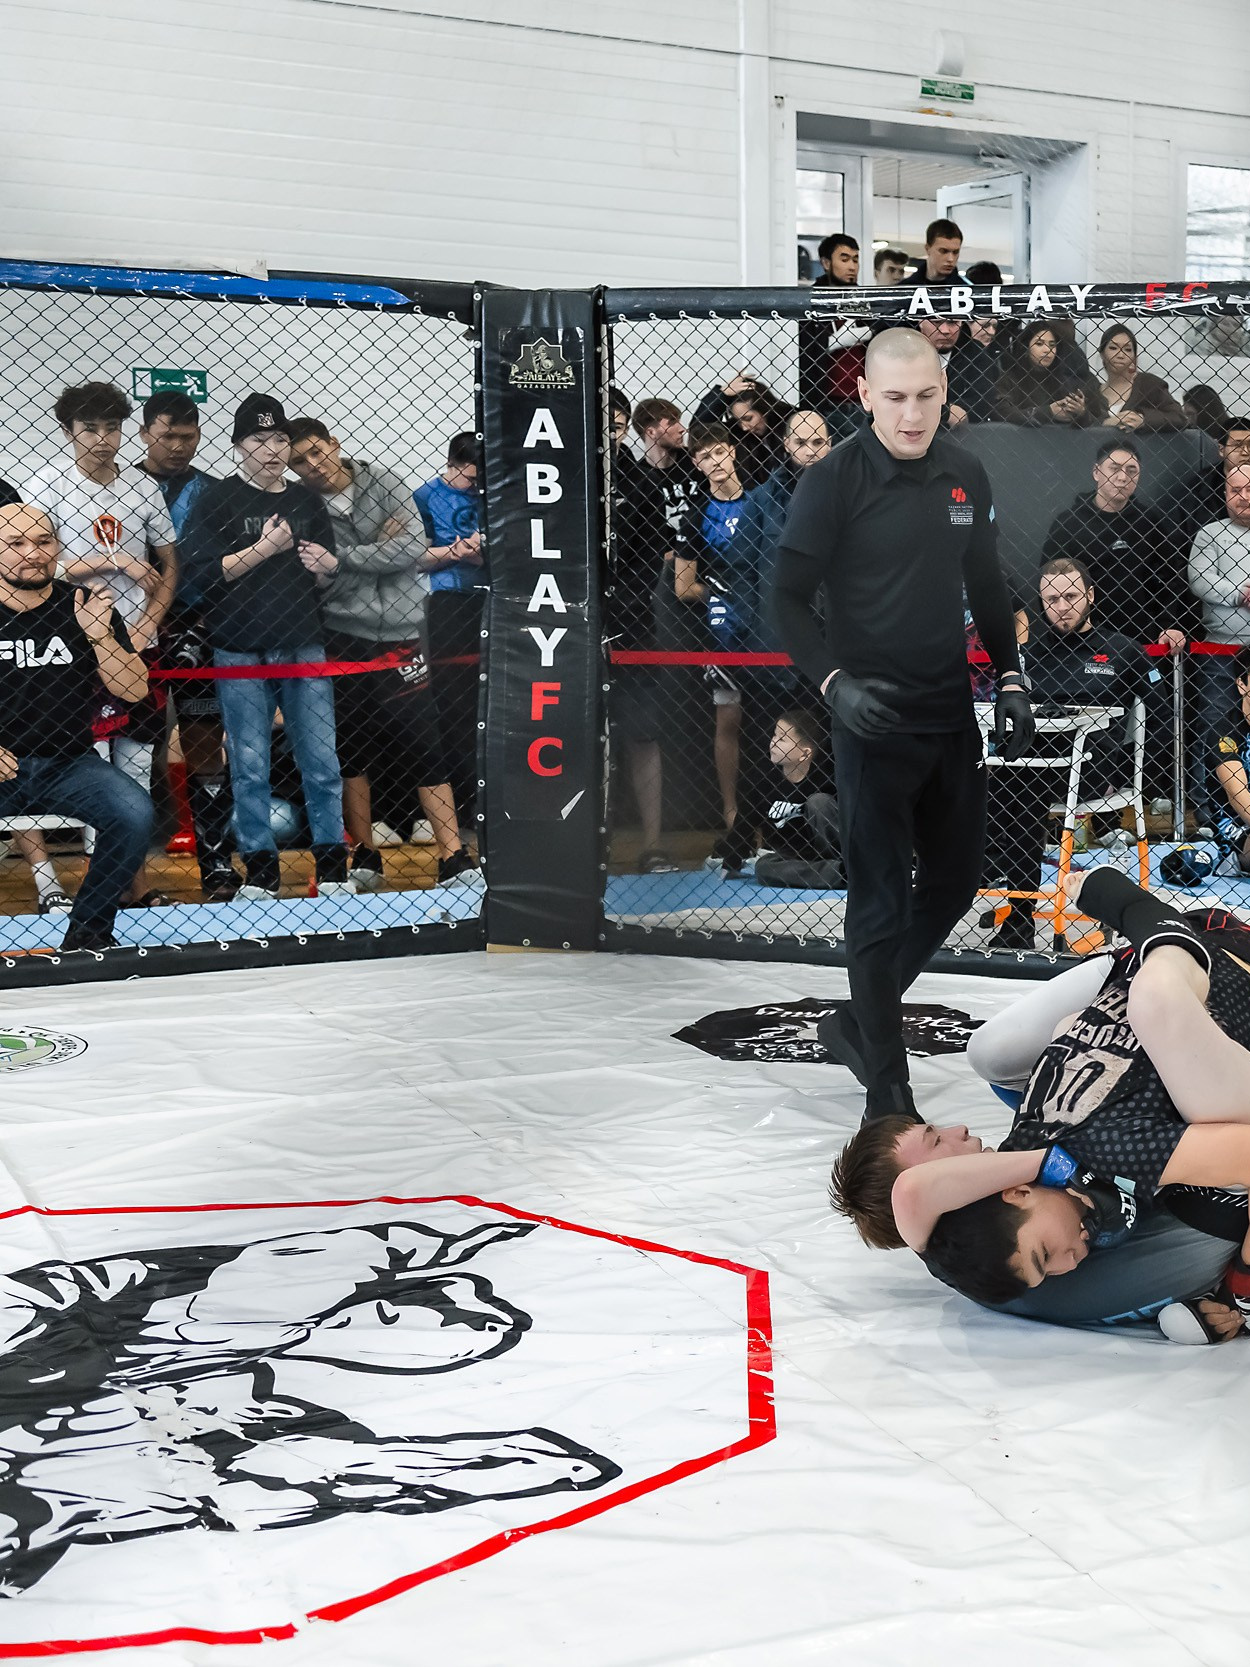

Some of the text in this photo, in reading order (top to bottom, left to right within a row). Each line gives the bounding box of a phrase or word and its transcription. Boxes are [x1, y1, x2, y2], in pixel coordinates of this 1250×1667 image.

[908, 282, 1209, 316] ABLAY FC
[522, 408, 567, 777] ABLAY FC
